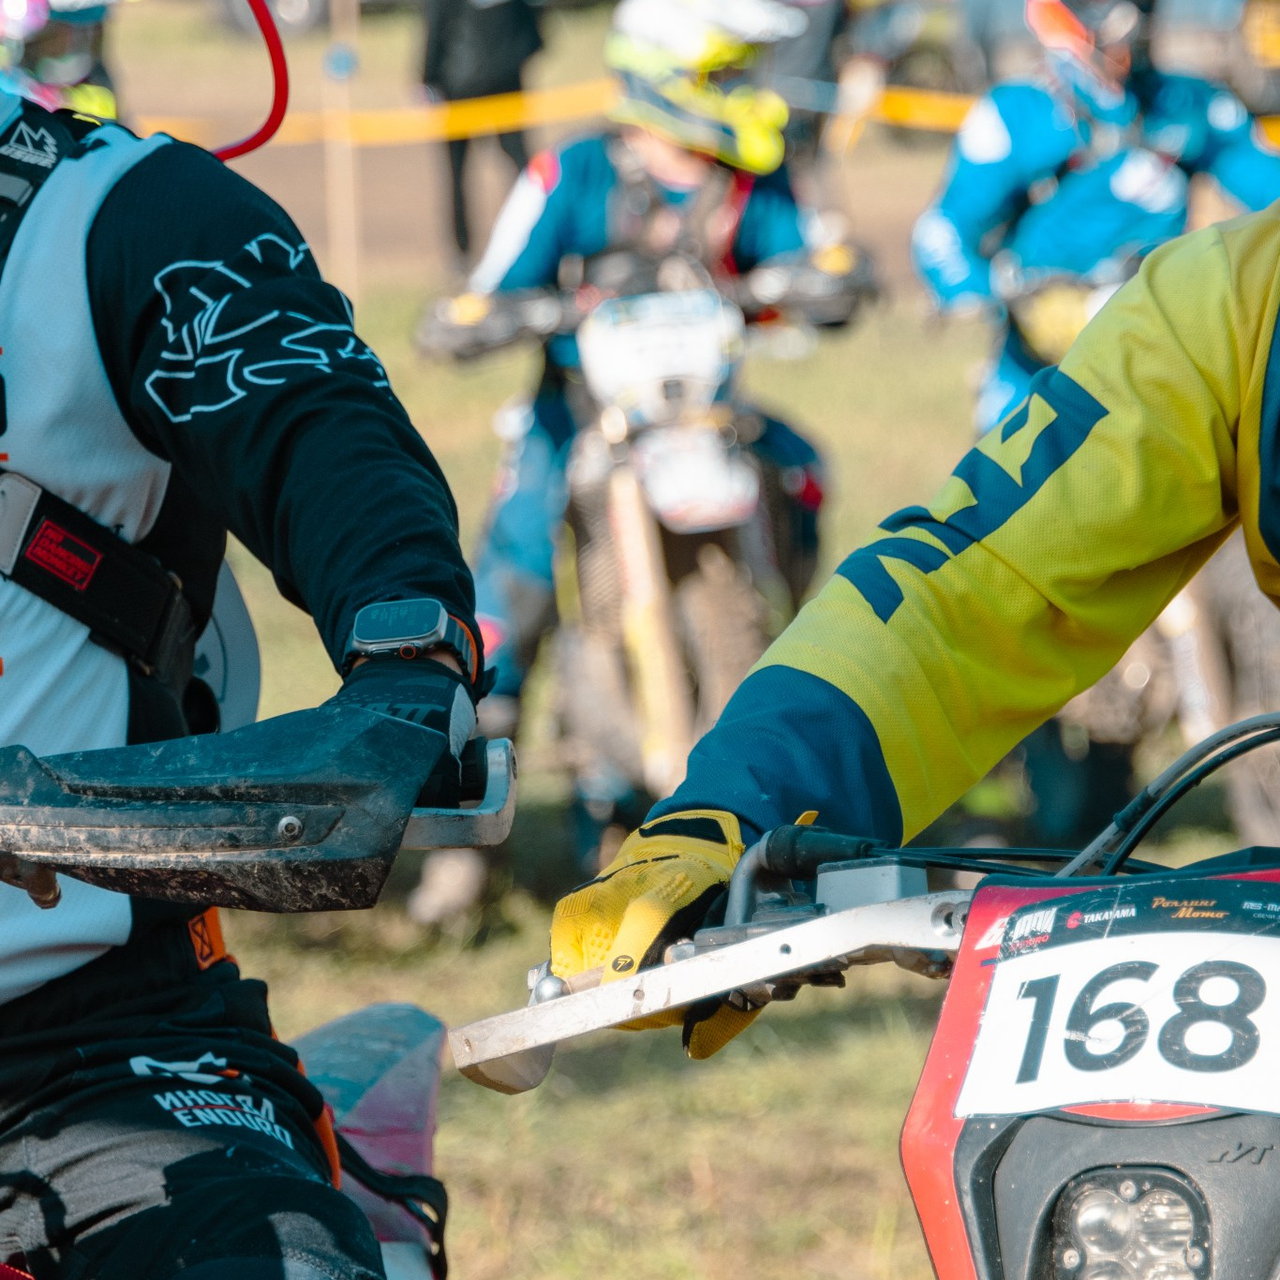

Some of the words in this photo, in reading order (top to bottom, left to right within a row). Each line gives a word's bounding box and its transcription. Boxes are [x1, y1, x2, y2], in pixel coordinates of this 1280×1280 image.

[1083, 906, 1136, 924] TAKAYAMA
[1015, 959, 1267, 1085] 168
[173, 1106, 295, 1150] ENDURO
